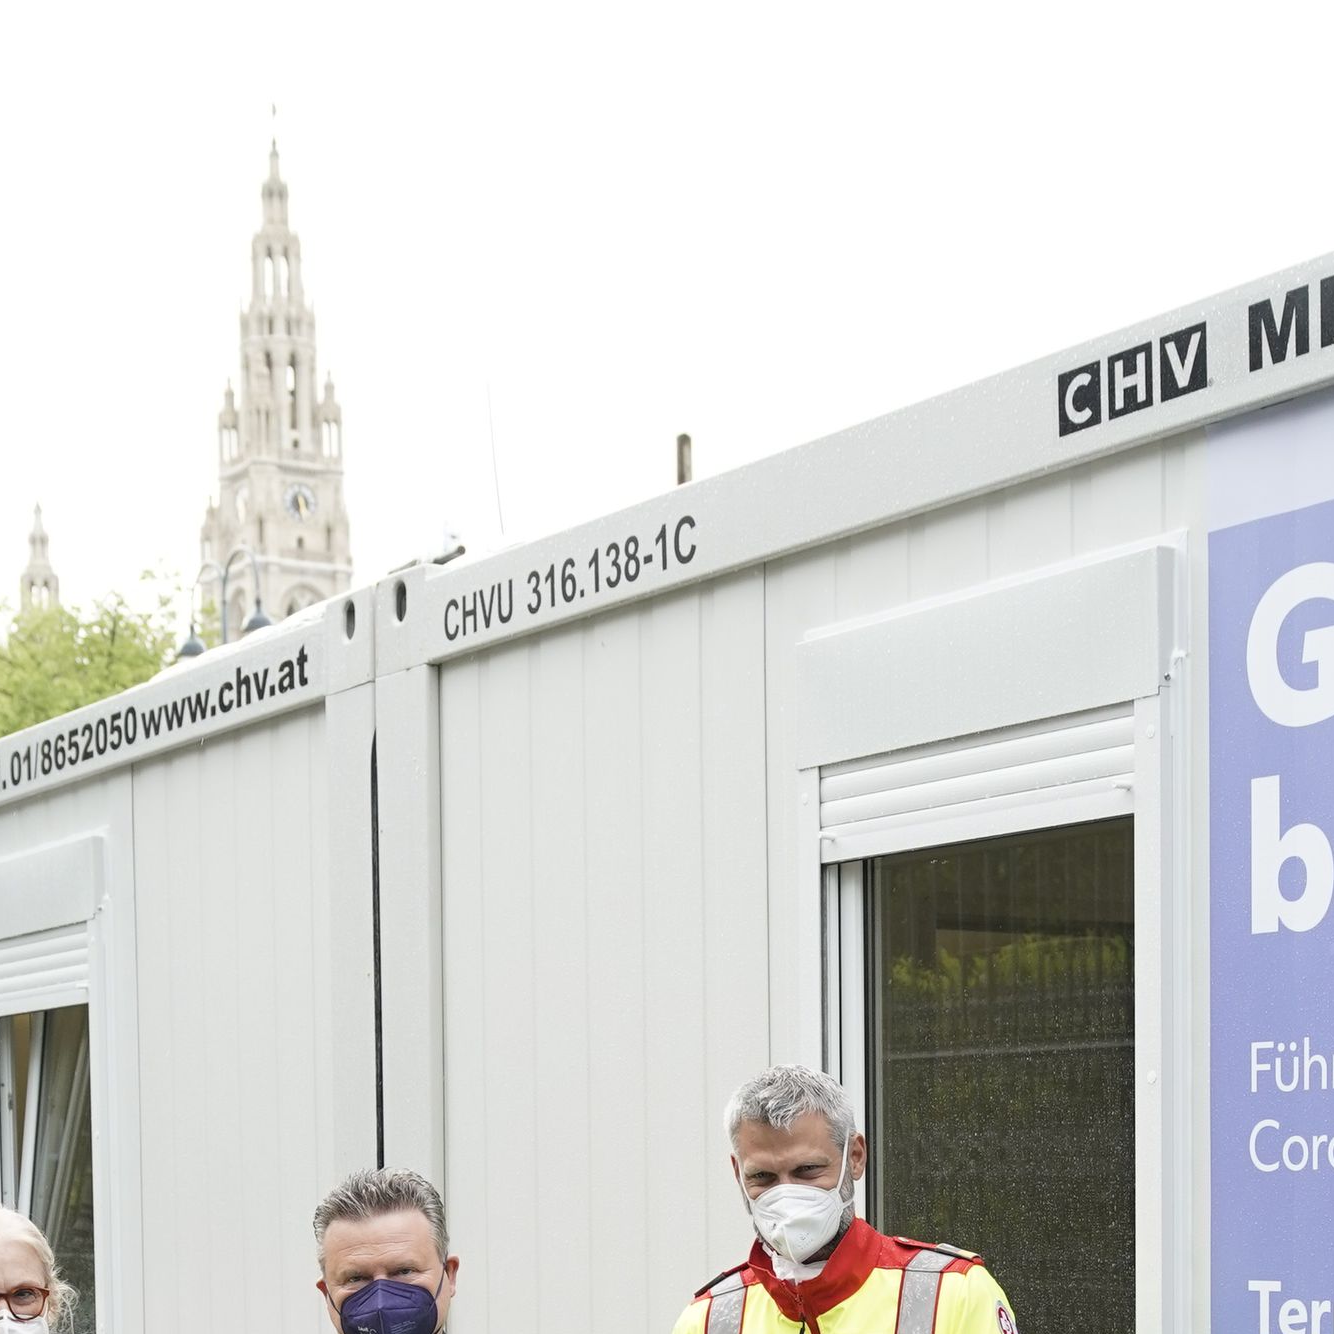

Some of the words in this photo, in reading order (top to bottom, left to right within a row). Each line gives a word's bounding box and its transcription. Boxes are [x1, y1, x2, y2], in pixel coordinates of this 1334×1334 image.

[1058, 321, 1207, 438] CHV
[444, 578, 513, 641] CHVU
[527, 515, 697, 615] 316.138-1C
